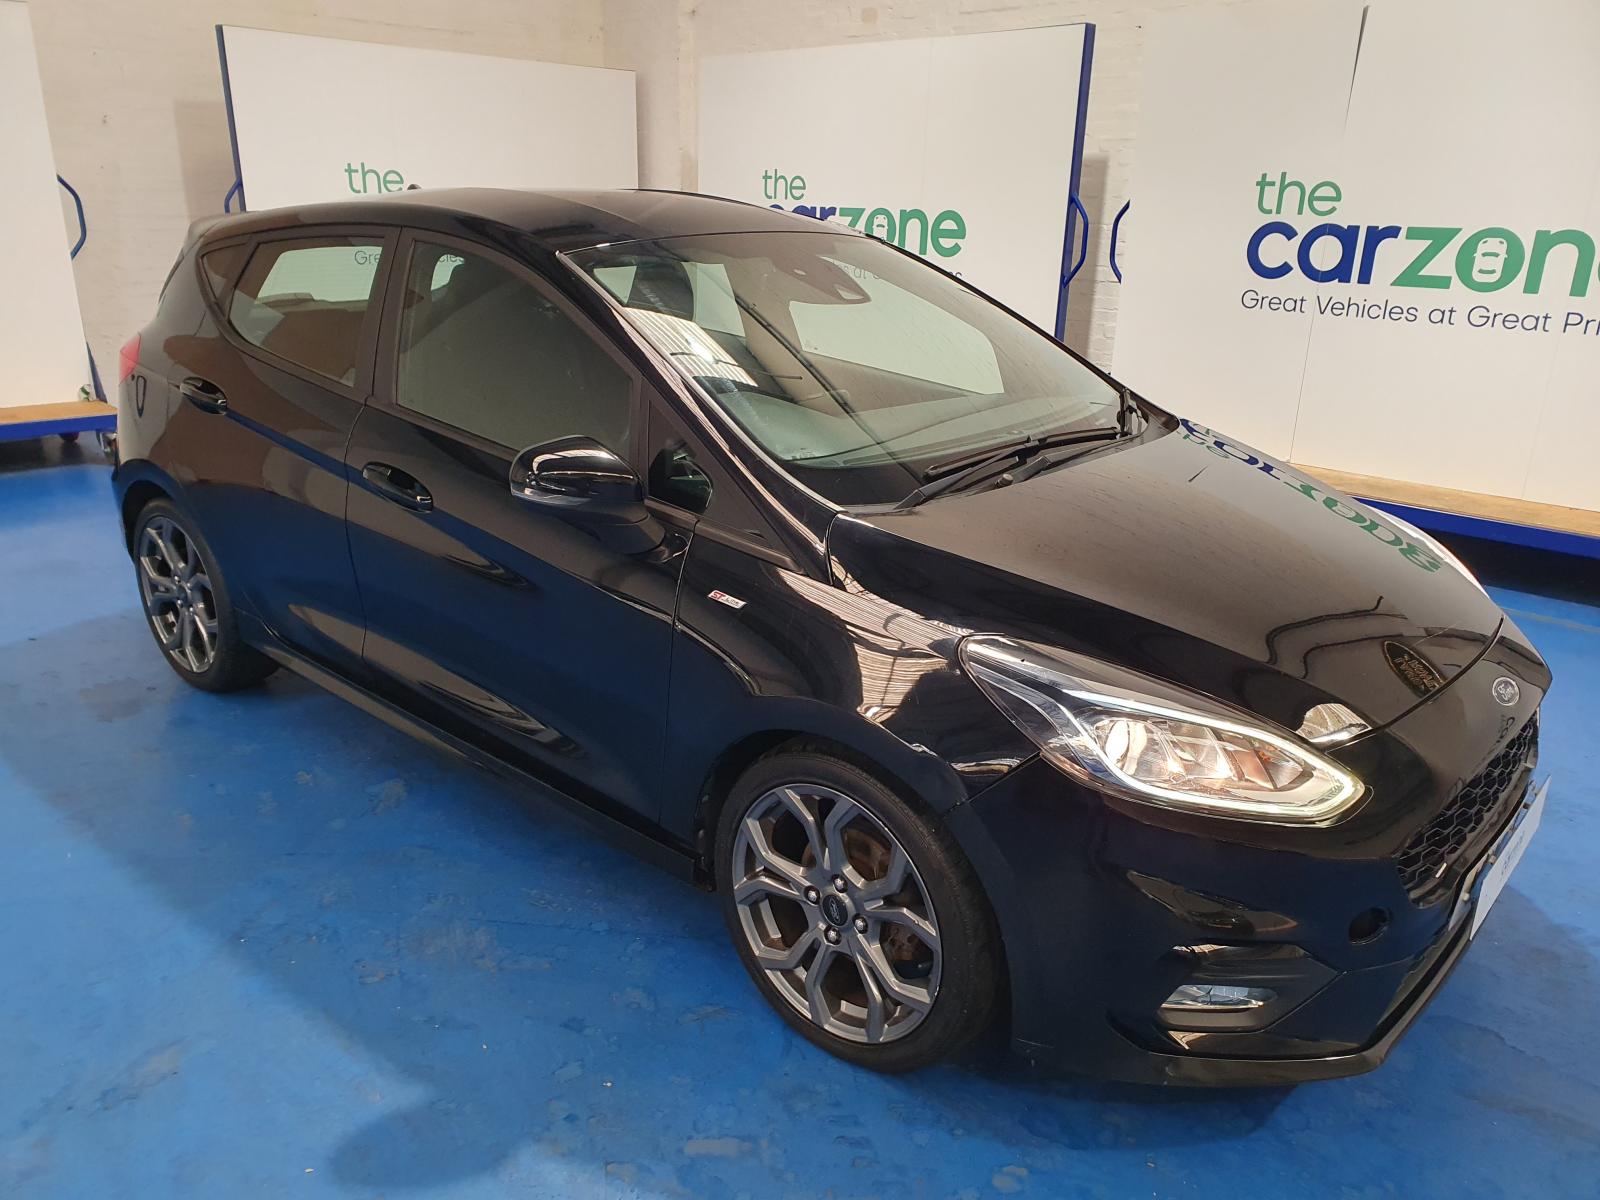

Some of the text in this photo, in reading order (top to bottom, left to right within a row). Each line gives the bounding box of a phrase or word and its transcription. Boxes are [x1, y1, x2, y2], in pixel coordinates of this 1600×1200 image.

[344, 162, 405, 194] the
[762, 168, 807, 200] the
[1255, 171, 1342, 217] the
[1246, 221, 1600, 298] carzon
[1240, 289, 1308, 314] Great
[1316, 295, 1419, 323] Vehicles
[1427, 306, 1457, 326] at
[1466, 305, 1553, 333] Great
